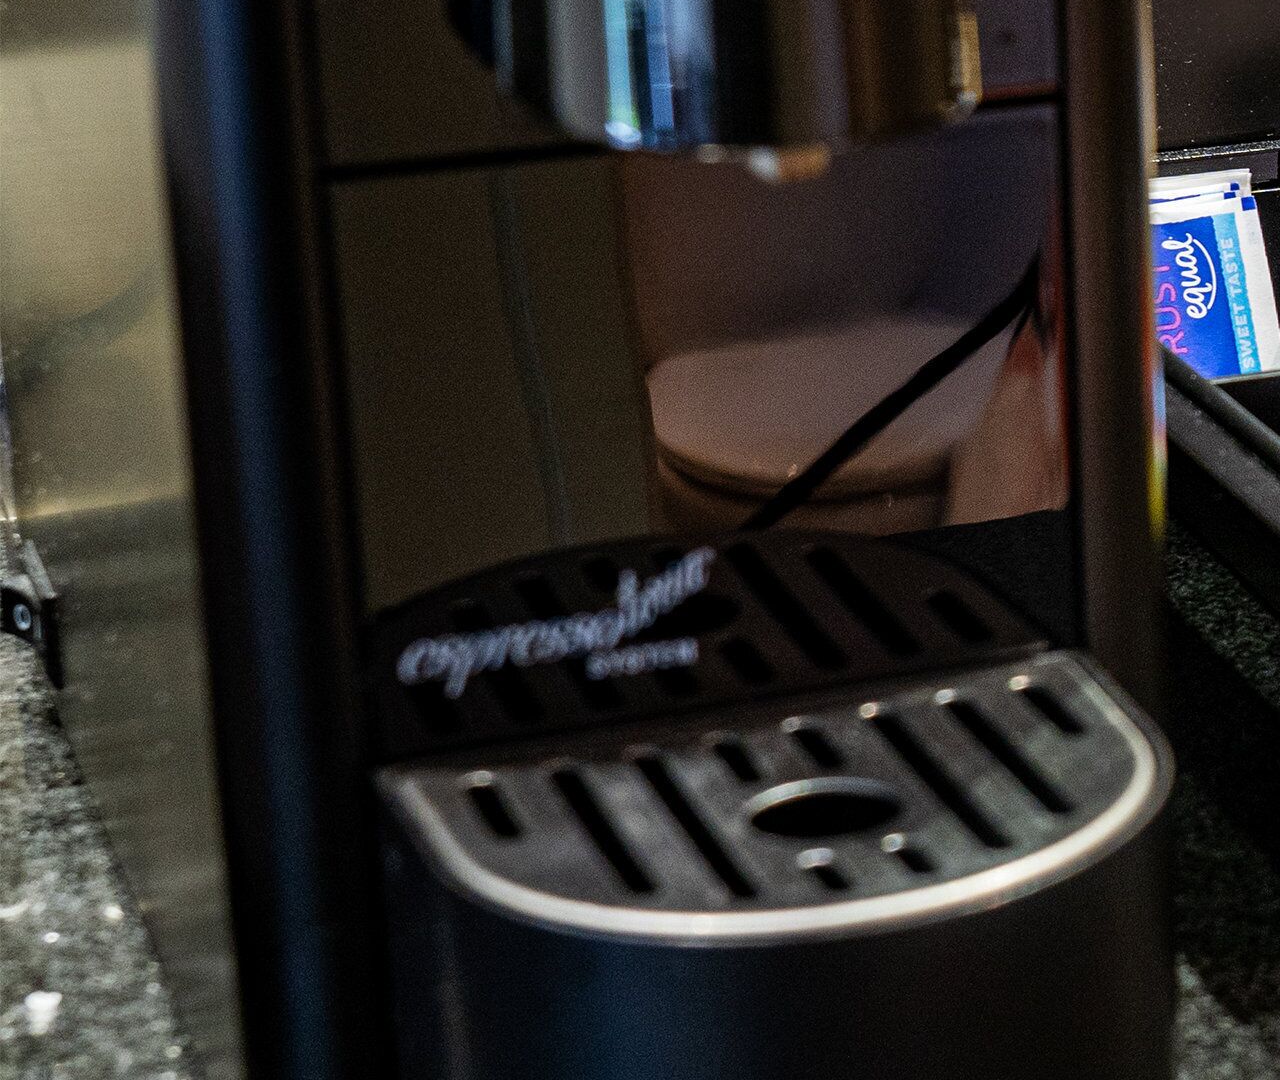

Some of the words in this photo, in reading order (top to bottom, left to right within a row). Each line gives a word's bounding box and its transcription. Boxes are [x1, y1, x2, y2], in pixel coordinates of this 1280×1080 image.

[1161, 232, 1213, 319] equal
[1219, 236, 1241, 297] TASTE
[1232, 303, 1256, 370] SWEET
